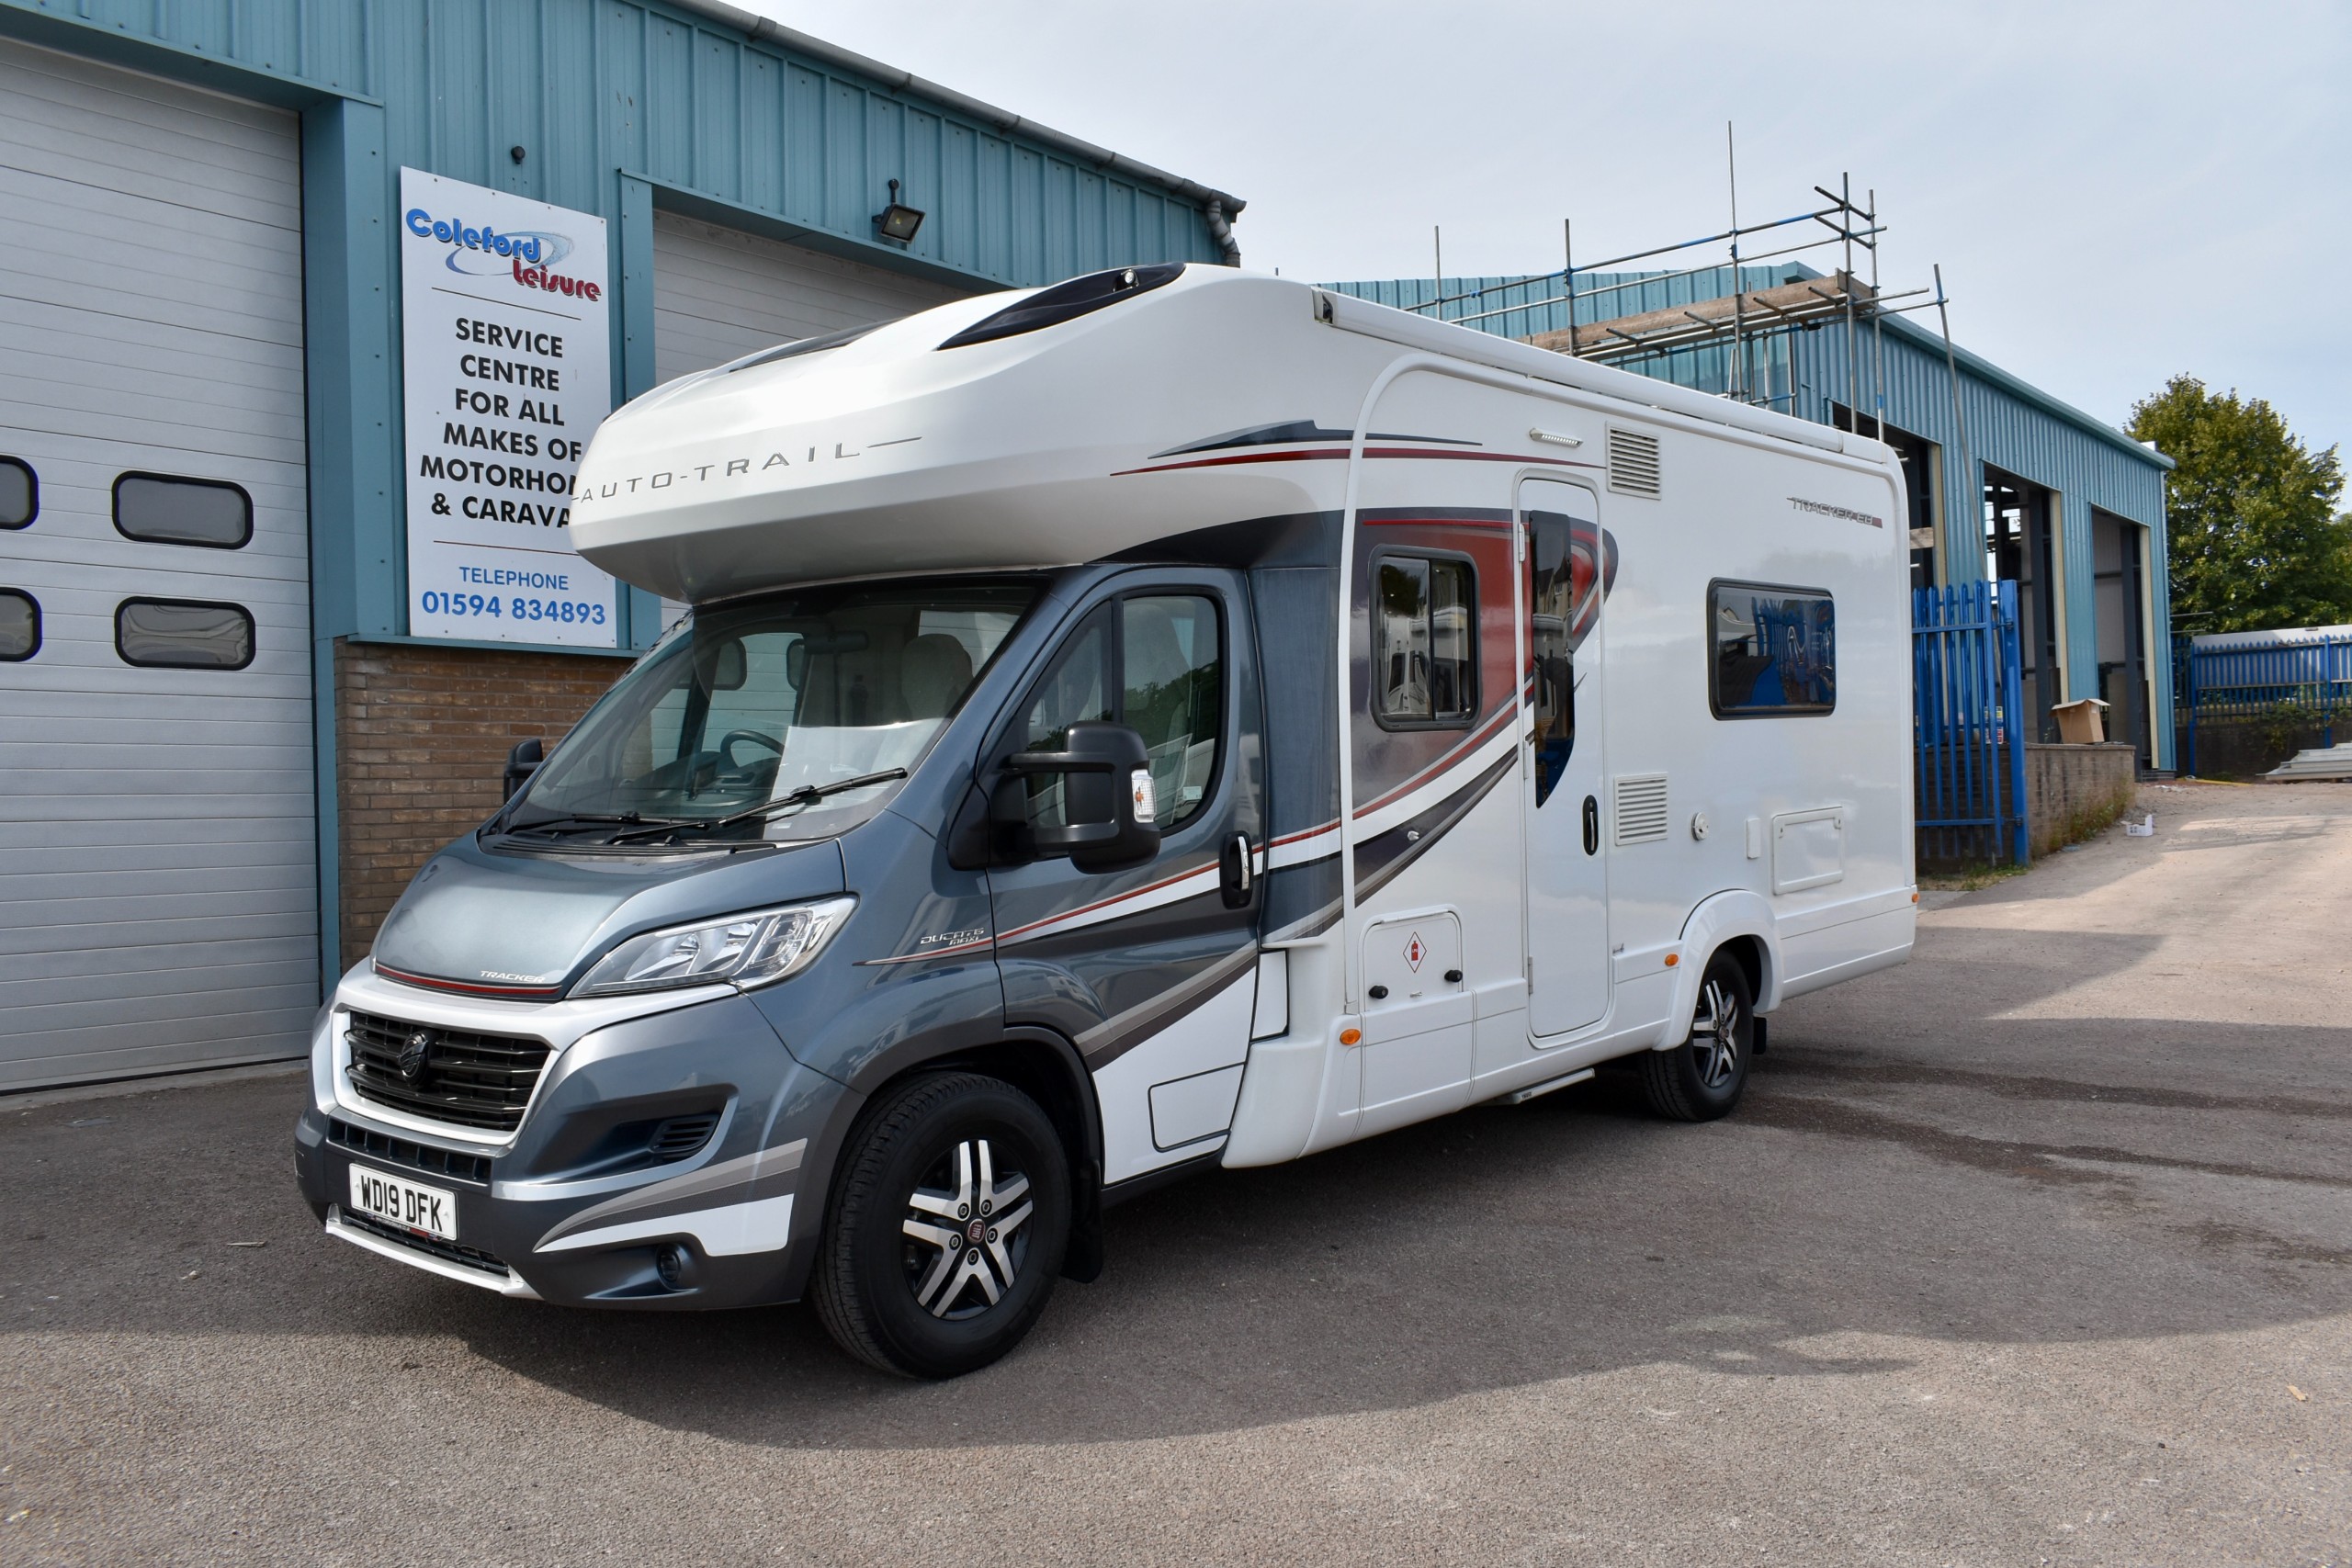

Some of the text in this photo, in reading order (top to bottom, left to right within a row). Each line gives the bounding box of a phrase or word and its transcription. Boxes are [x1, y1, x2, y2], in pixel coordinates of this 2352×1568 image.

[406, 209, 541, 262] Coleford
[513, 259, 602, 301] Leisure
[455, 317, 563, 358] SERVICE
[460, 354, 560, 391] CENTRE
[456, 388, 565, 426] FOR ALL
[443, 422, 582, 462] MAKES OF
[420, 455, 576, 496] MOTORHO
[581, 442, 860, 504] AUTO-TRAIL
[431, 492, 452, 516] &
[1792, 497, 1853, 521] TRACKER
[459, 566, 569, 591] TELEPHONE
[422, 591, 606, 625] 01594 834893
[481, 970, 546, 983] TRACKER
[361, 1175, 443, 1232] WD19 DFK
